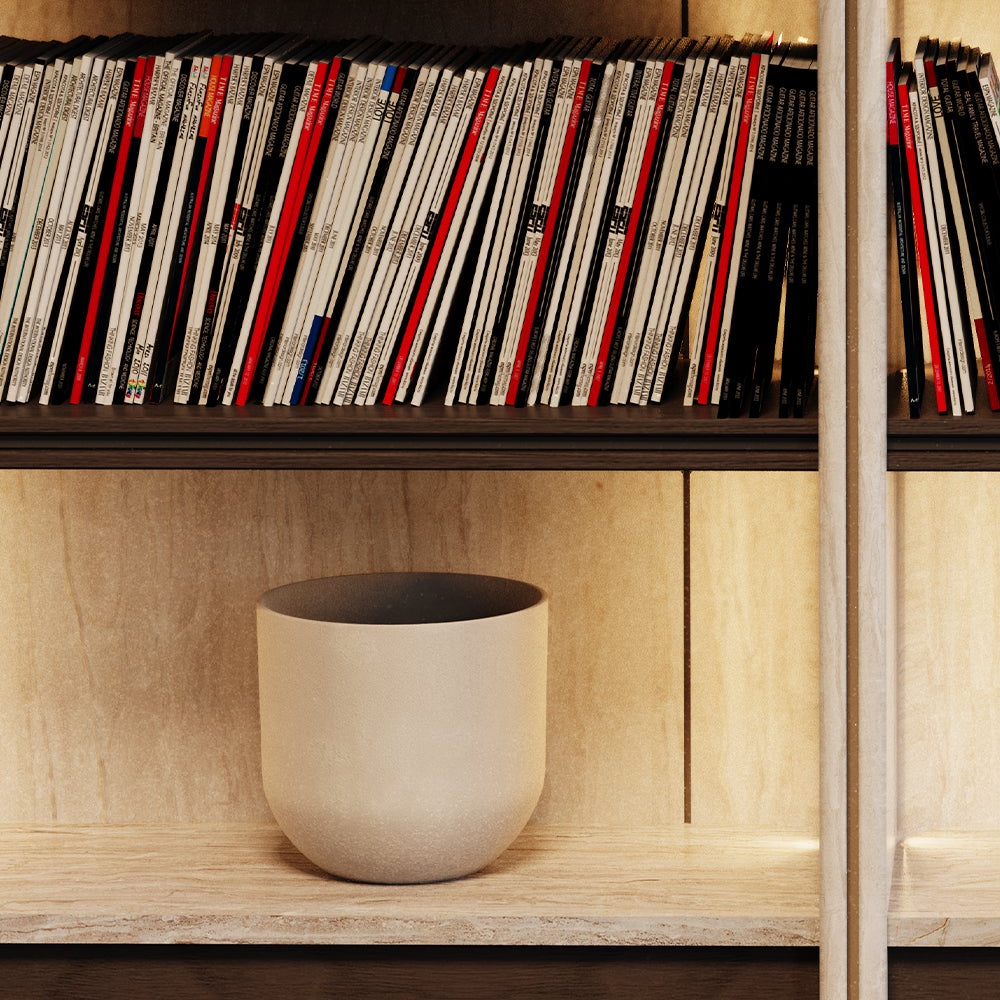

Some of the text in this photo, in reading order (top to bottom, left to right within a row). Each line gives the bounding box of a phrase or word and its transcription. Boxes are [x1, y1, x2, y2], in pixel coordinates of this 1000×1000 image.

[14, 73, 30, 115] DETAIL MAGAZINE
[27, 70, 40, 103] ESPN MAGAZINE
[60, 74, 77, 121] ARCHITECTURAL DIGEST
[70, 71, 86, 119] ARCHITECTURAL DIGEST
[81, 73, 98, 121] ARCHITECTURAL DIGEST
[130, 78, 141, 98] TIME
[202, 75, 217, 117] HOUSE MAGAZINE
[216, 76, 227, 96] TIME
[236, 85, 246, 106] BAZAAR
[266, 69, 280, 102] ESPN MAGAZINE
[298, 70, 315, 111] DETAIL MAGAZINE
[310, 82, 321, 103] TIME
[565, 66, 579, 99] ESPN MAGAZINE
[657, 82, 668, 102] TIME
[721, 86, 732, 105] BAZAAR
[734, 64, 746, 98] ESPN MAGAZINE
[30, 78, 51, 144] INTERIOR DESIGN MAGAZINE
[96, 88, 107, 108] BAZAAR
[149, 59, 171, 143] THE OFFICIAL MAGAZINE BRITAIN
[171, 97, 182, 122] MAGAZINE
[338, 79, 362, 145] INTERIOR DESIGN MAGAZINE
[357, 78, 381, 143] INTERIOR DESIGN MAGAZINE
[372, 98, 385, 121] LOVE
[450, 98, 463, 117] BAZAAR
[900, 104, 909, 123] TIME
[916, 72, 933, 140] INTERIOR DESIGN MAGAZINE
[929, 95, 943, 119] LOVE
[981, 84, 997, 117] ESPN MAGAZINE
[780, 137, 790, 164] MAGAZINE
[976, 141, 988, 163] MAGAZINE
[138, 222, 146, 235] MAY
